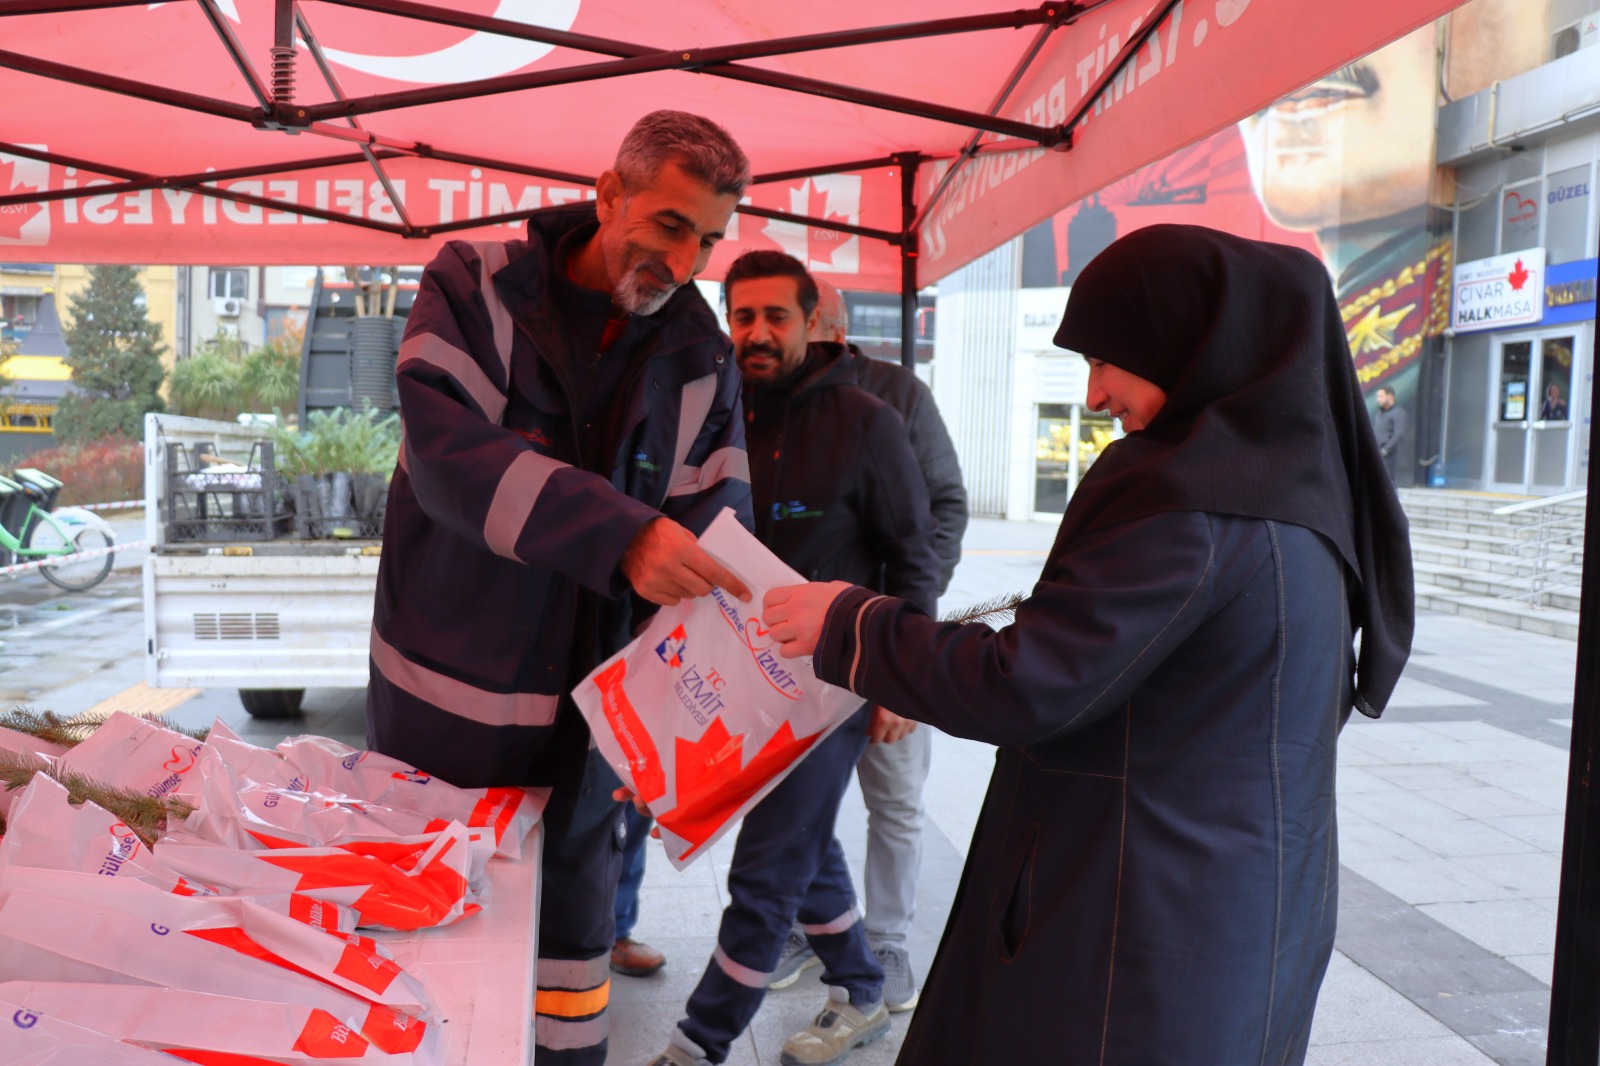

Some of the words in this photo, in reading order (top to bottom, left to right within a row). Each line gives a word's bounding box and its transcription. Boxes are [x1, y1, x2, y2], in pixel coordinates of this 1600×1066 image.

[1547, 183, 1590, 204] GÜZEL
[1459, 281, 1504, 306] ÇINAR
[757, 649, 796, 689] İZMİT
[674, 680, 710, 727] BELEDİYESİ
[681, 664, 725, 716] İZMİT
[149, 772, 181, 799] ülümse
